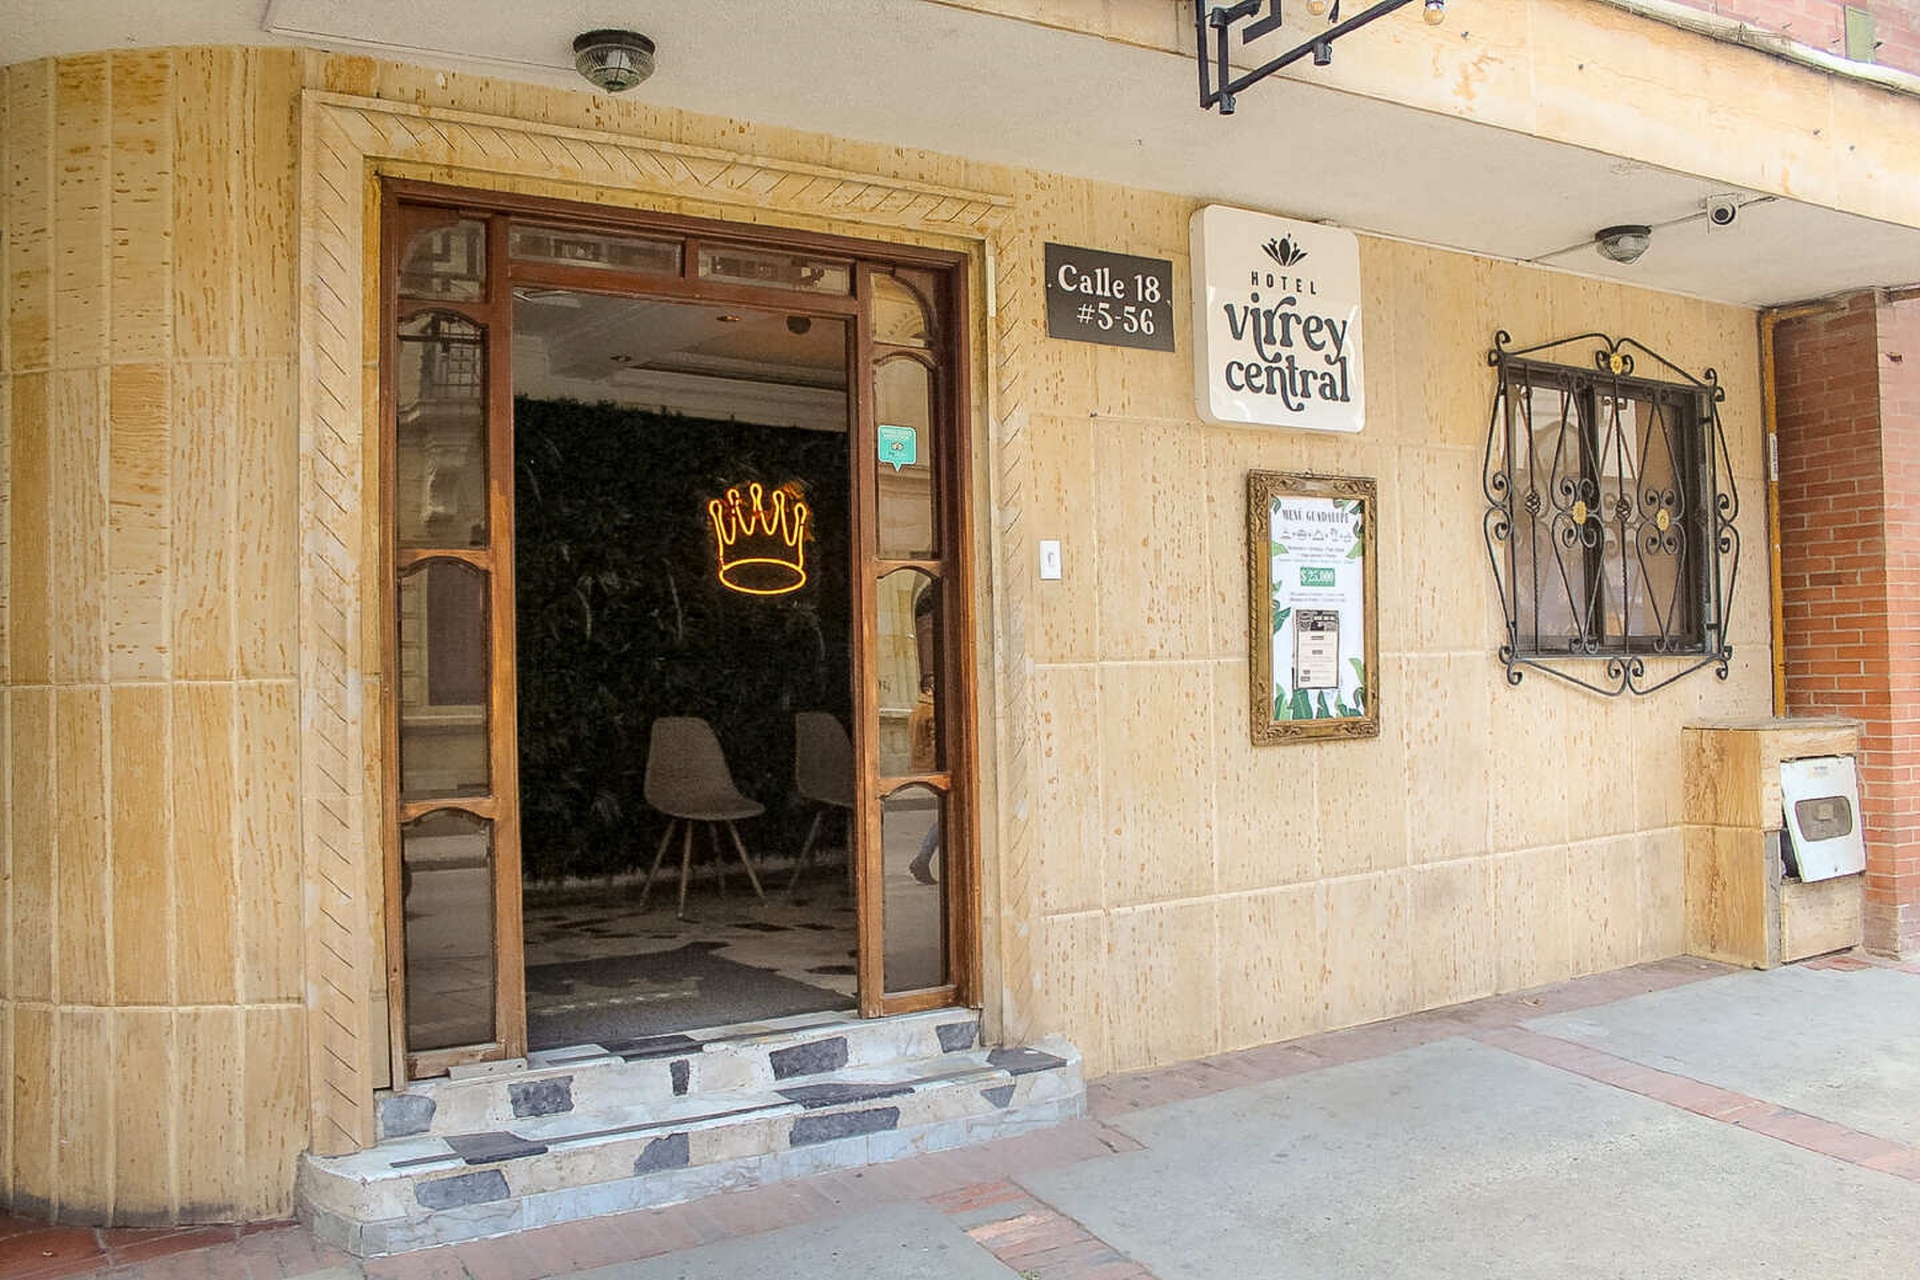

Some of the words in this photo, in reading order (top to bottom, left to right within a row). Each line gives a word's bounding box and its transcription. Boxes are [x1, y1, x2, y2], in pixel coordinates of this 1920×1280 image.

[1058, 264, 1125, 299] Calle
[1134, 274, 1161, 303] 18
[1251, 271, 1317, 295] HOTEL
[1077, 302, 1155, 335] #5-56
[1223, 292, 1348, 365] virrey
[1225, 355, 1350, 411] central
